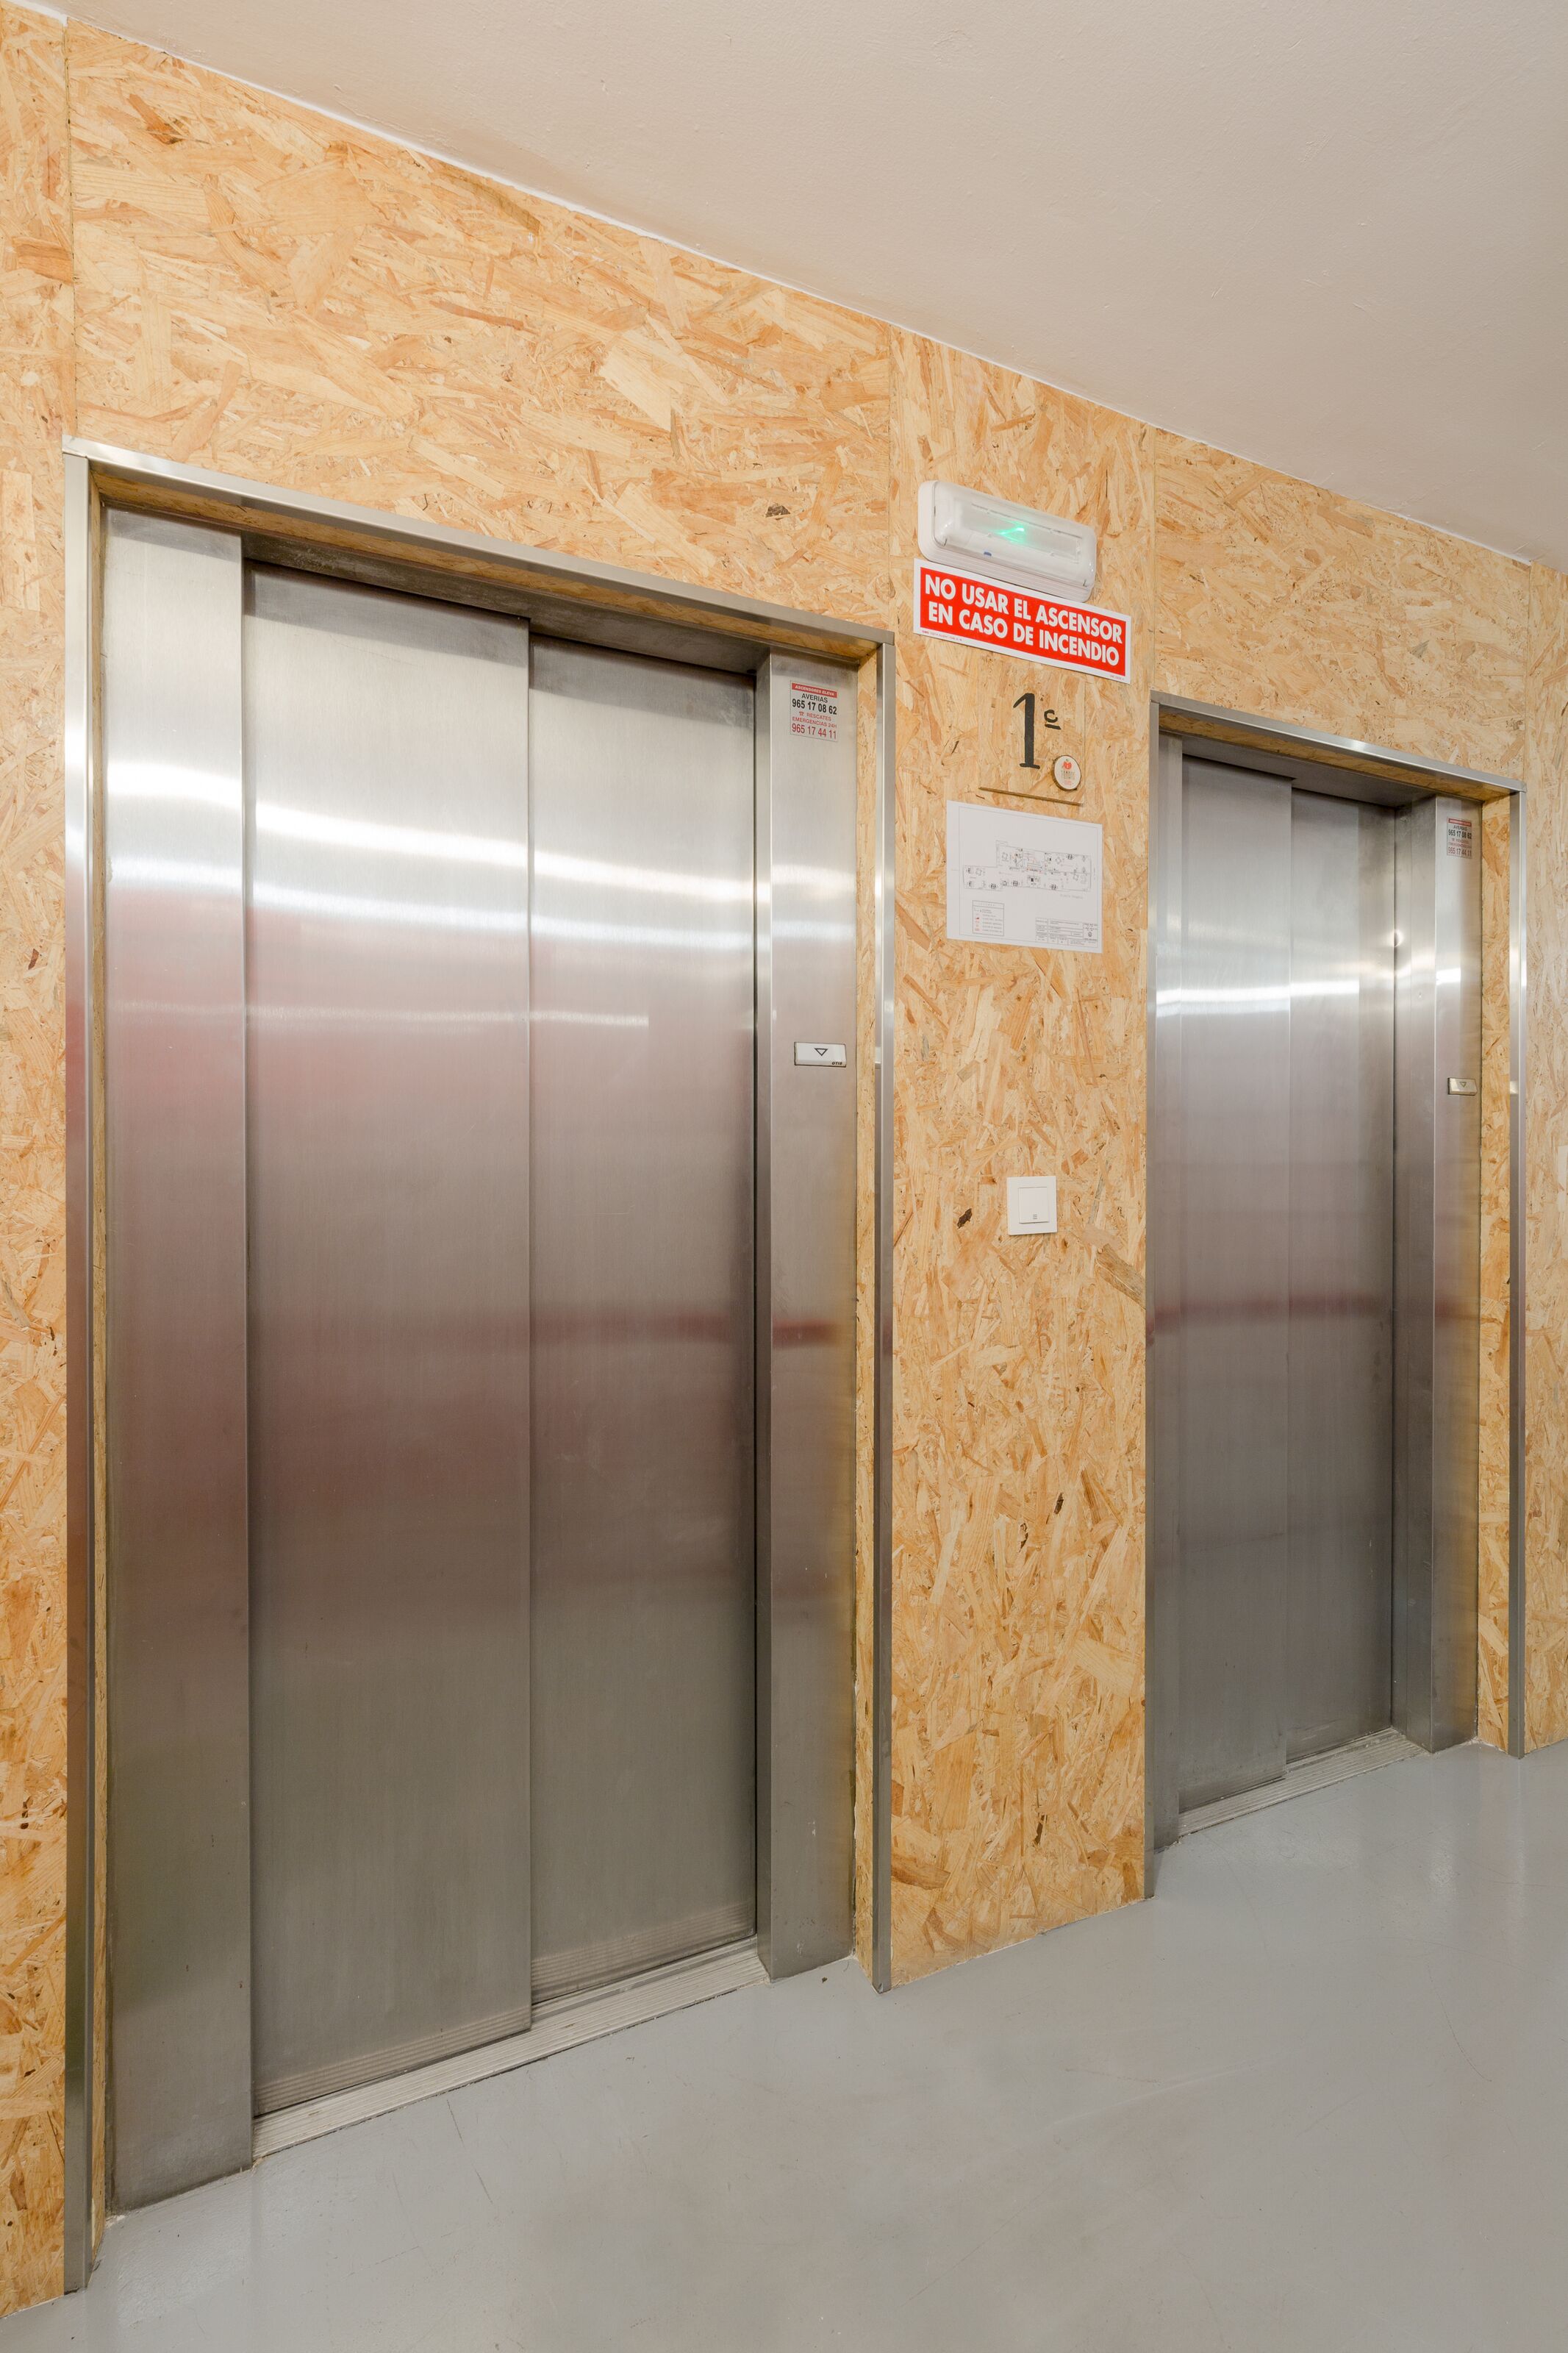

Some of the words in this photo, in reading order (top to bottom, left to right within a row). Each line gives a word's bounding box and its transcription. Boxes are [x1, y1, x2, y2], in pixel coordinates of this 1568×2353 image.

[925, 574, 956, 601] NO
[962, 583, 1009, 615] USAR
[1014, 597, 1031, 621] EL
[1035, 604, 1123, 644] ASCENSOR
[928, 601, 953, 626] EN
[959, 610, 1008, 640] CASO
[1013, 623, 1034, 646] DE
[1039, 629, 1120, 665] INCENDIO
[795, 685, 821, 693] ASCENSORES
[801, 693, 828, 703] AVERIAS
[792, 699, 805, 709] 965
[807, 701, 816, 710] 17
[818, 703, 826, 713] 08
[828, 705, 837, 715] 62
[792, 716, 827, 726] EMERGENCIAS
[806, 712, 831, 721] RESCATES
[792, 723, 805, 734] 965
[808, 726, 816, 735] 17
[817, 727, 827, 738] 44
[828, 729, 837, 739] 11
